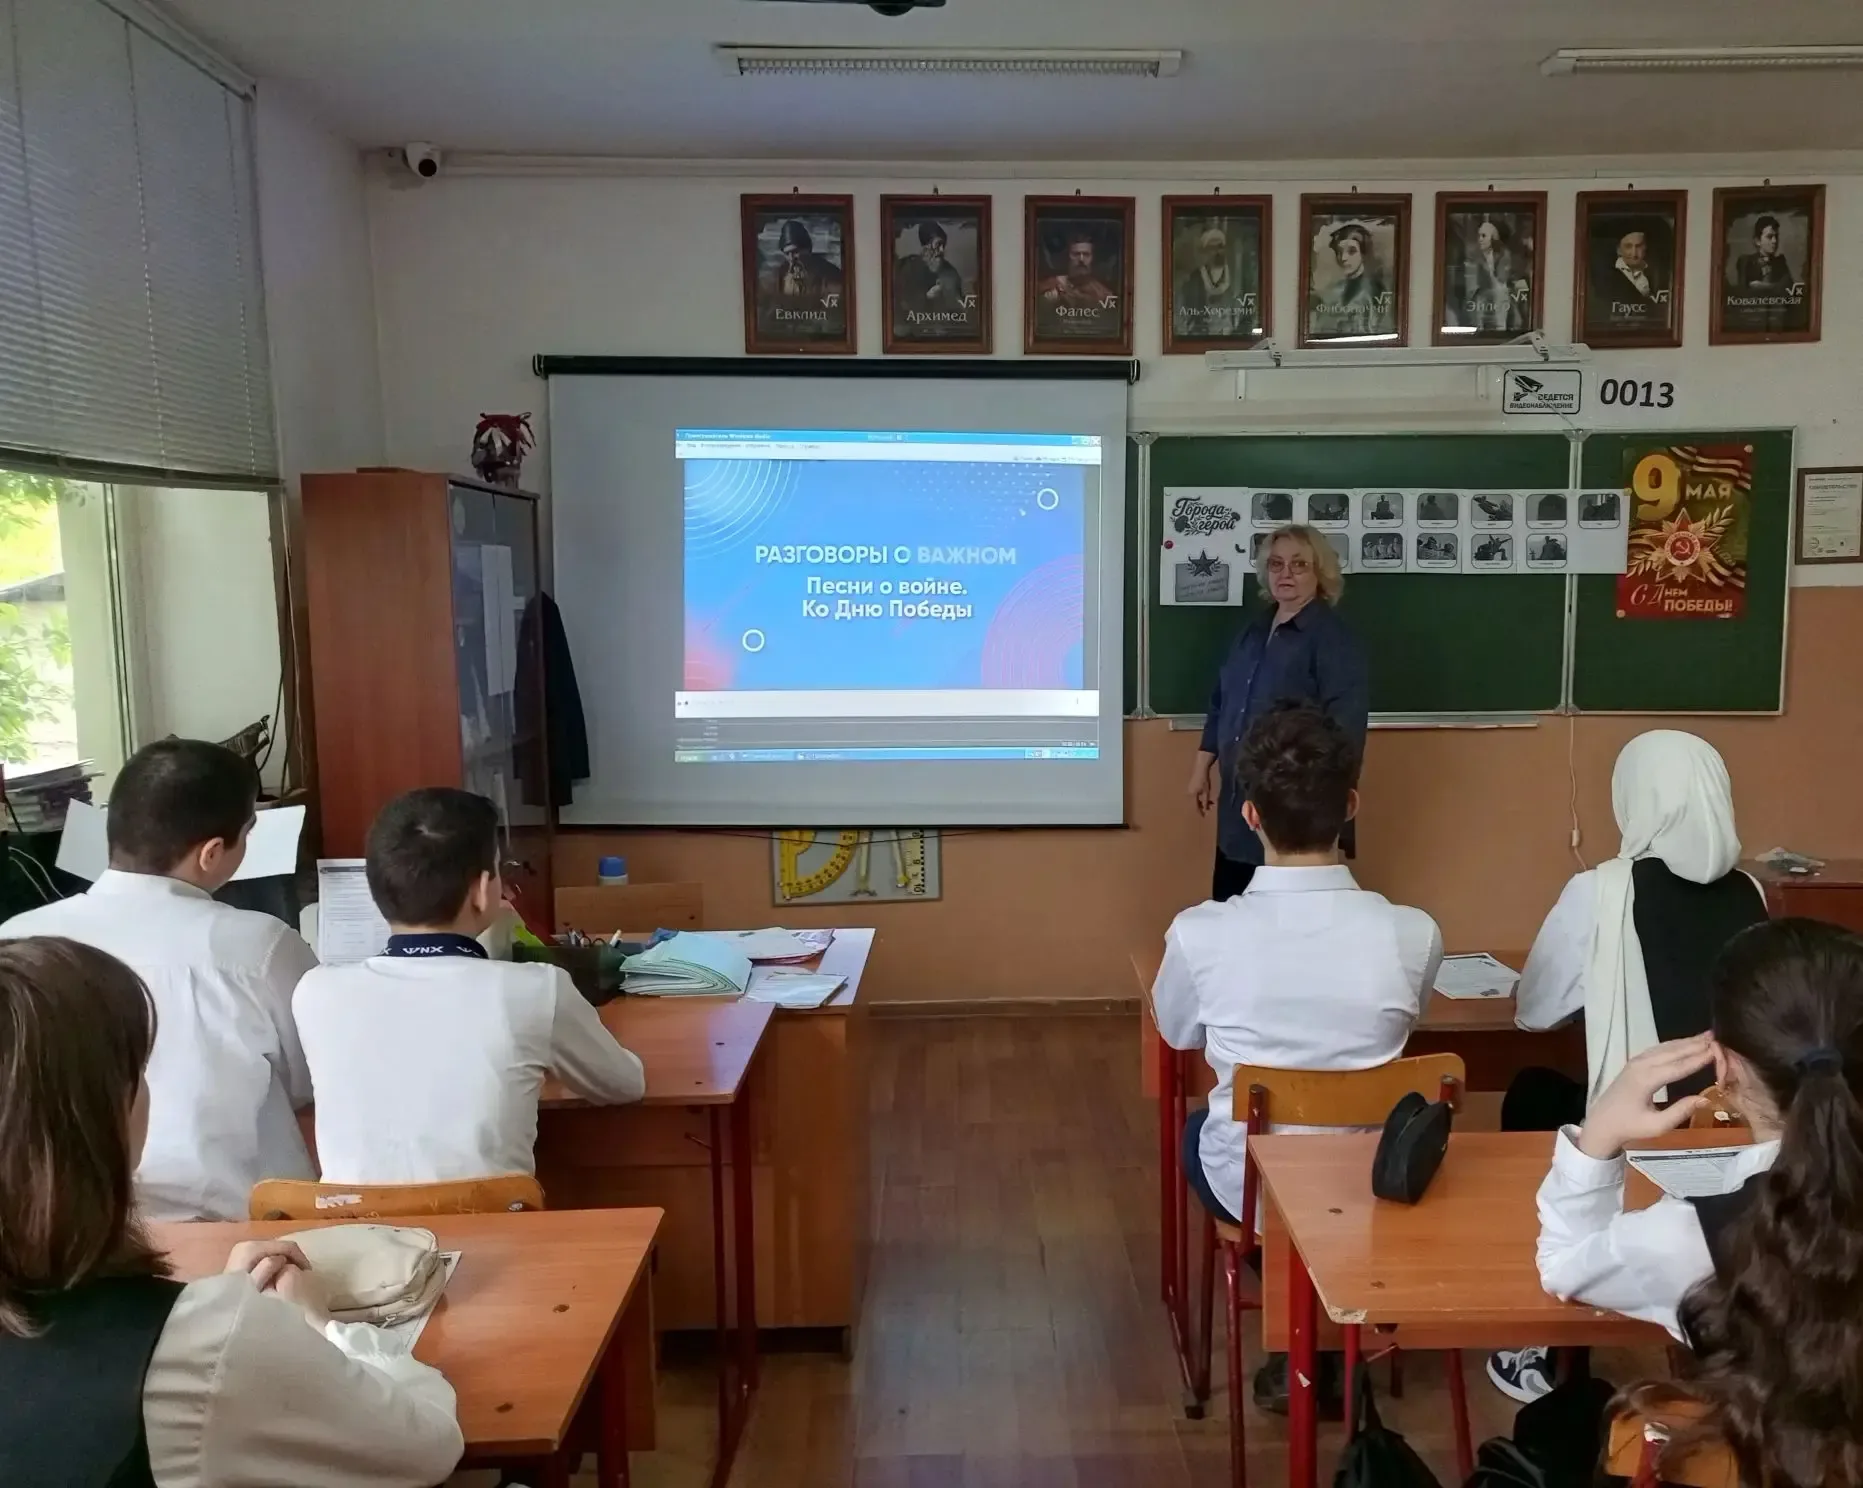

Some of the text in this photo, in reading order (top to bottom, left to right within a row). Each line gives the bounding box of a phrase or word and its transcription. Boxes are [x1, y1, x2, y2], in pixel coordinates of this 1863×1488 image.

[1727, 295, 1802, 305] Ковалевская
[775, 308, 828, 321] Евклид
[906, 310, 968, 324] Архимед
[1055, 304, 1100, 318] Фалес
[1179, 305, 1254, 319] Аль-Хорезми
[1612, 301, 1647, 317] Гаусс
[1600, 378, 1674, 408] 0013
[1632, 454, 1733, 522] 9 МАЯ
[755, 544, 1017, 565] РАЗГОВОРЫ О ВАЖНОМ
[806, 576, 968, 596] Песни о войне.
[1630, 583, 1648, 606] С
[802, 599, 973, 621] Ко Дню Победы
[1664, 599, 1733, 613] ПОБЕДЫ!
